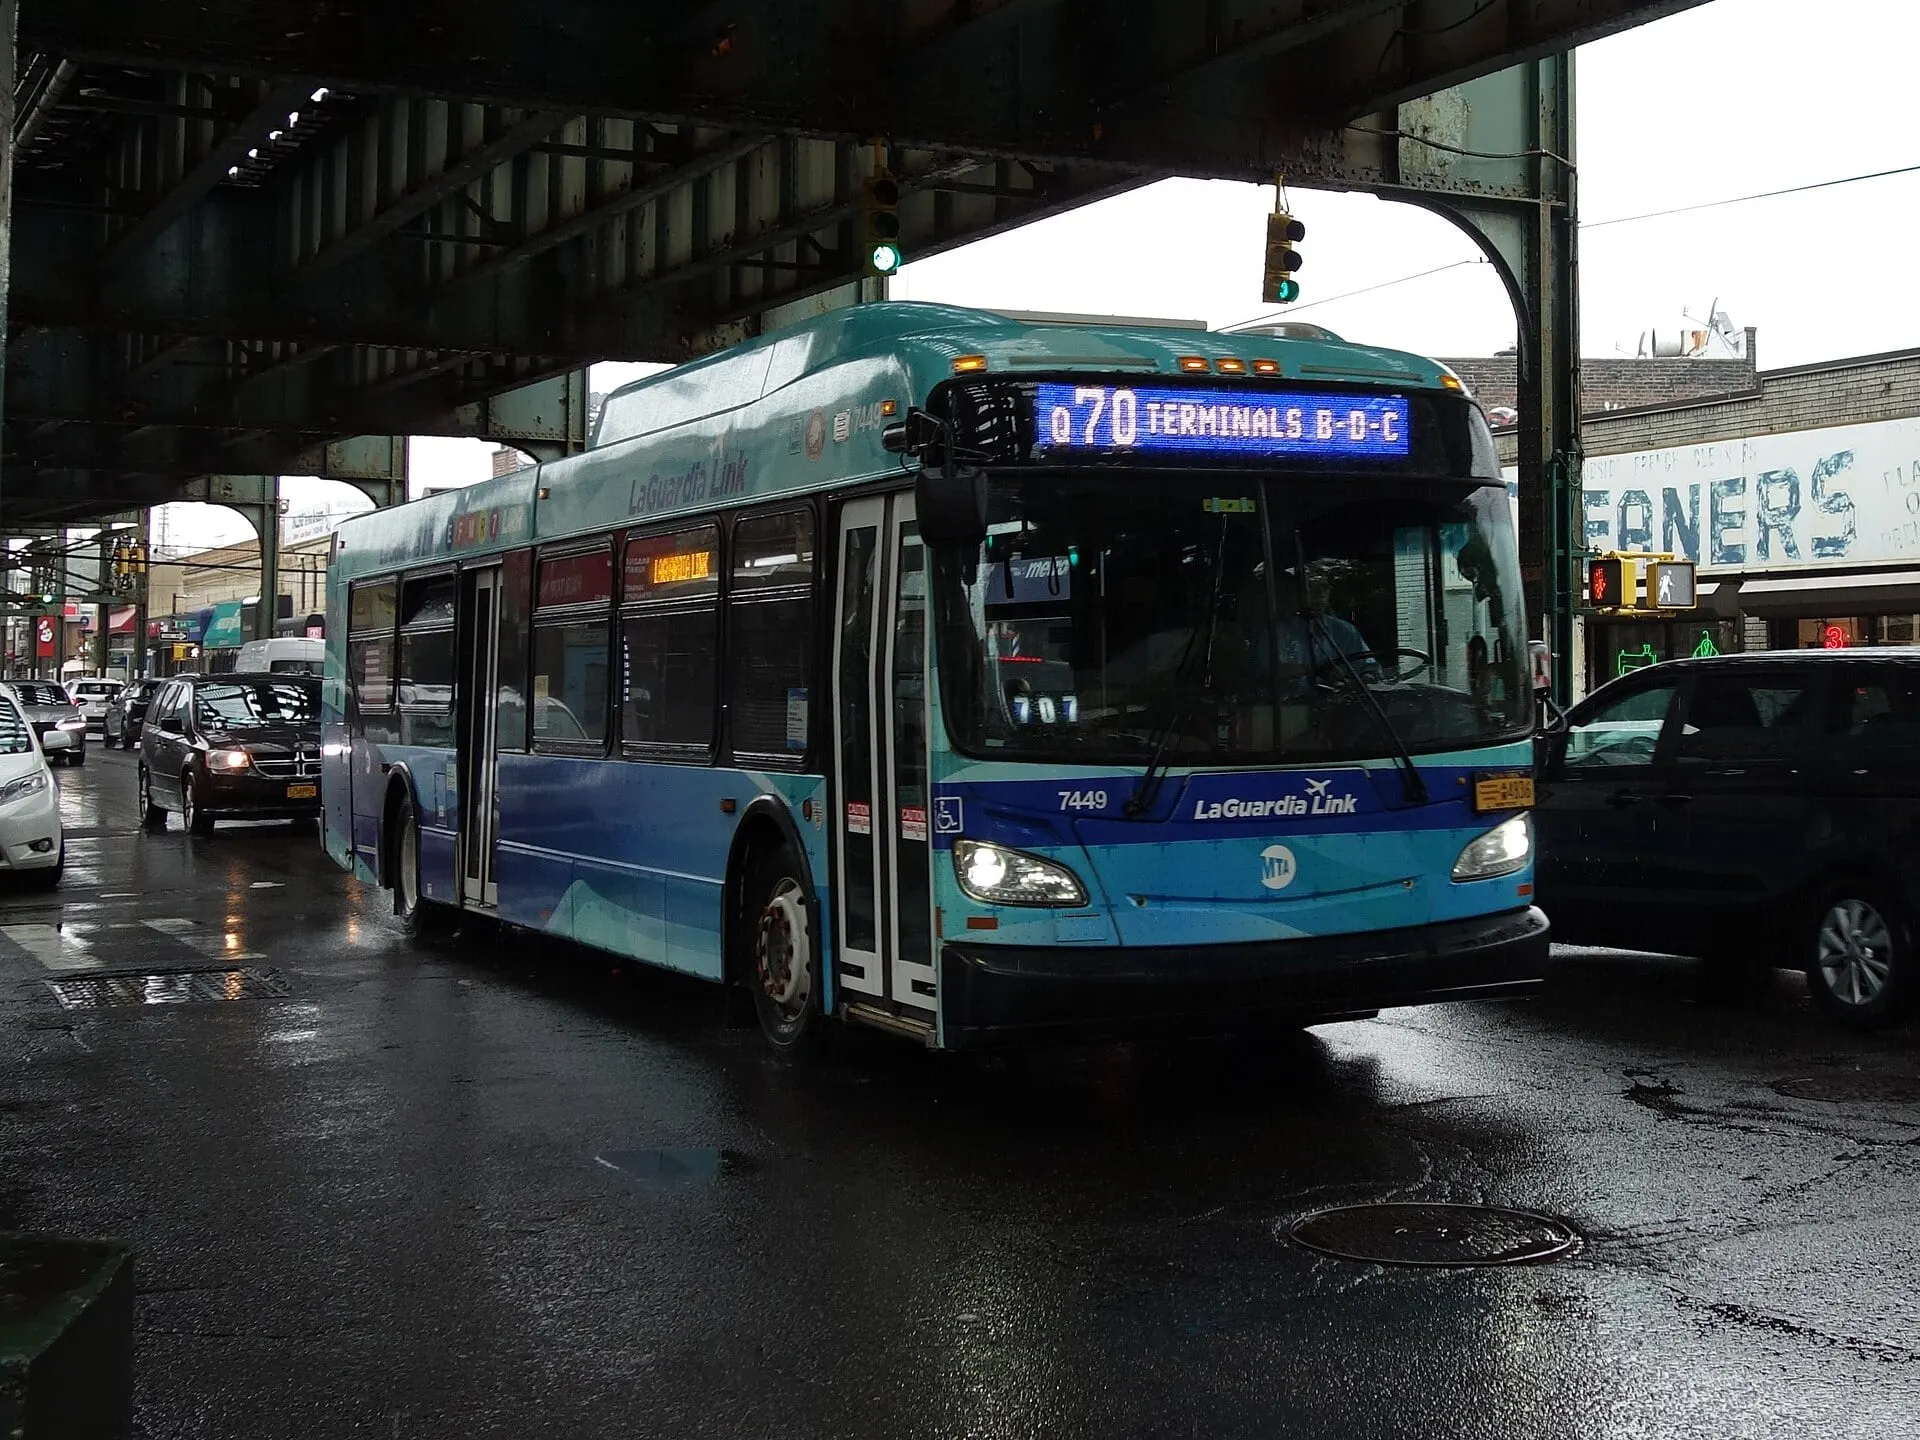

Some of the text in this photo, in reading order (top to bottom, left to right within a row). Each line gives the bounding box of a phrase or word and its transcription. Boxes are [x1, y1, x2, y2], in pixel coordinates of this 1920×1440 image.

[1051, 387, 1400, 445] Q70 TERMINALS B-D-C
[628, 450, 749, 515] LaGuardia Link
[1584, 448, 1858, 576] EANERS
[1058, 791, 1107, 811] 7449
[1194, 793, 1358, 819] LaGuardia Link
[1261, 855, 1290, 880] MTA
